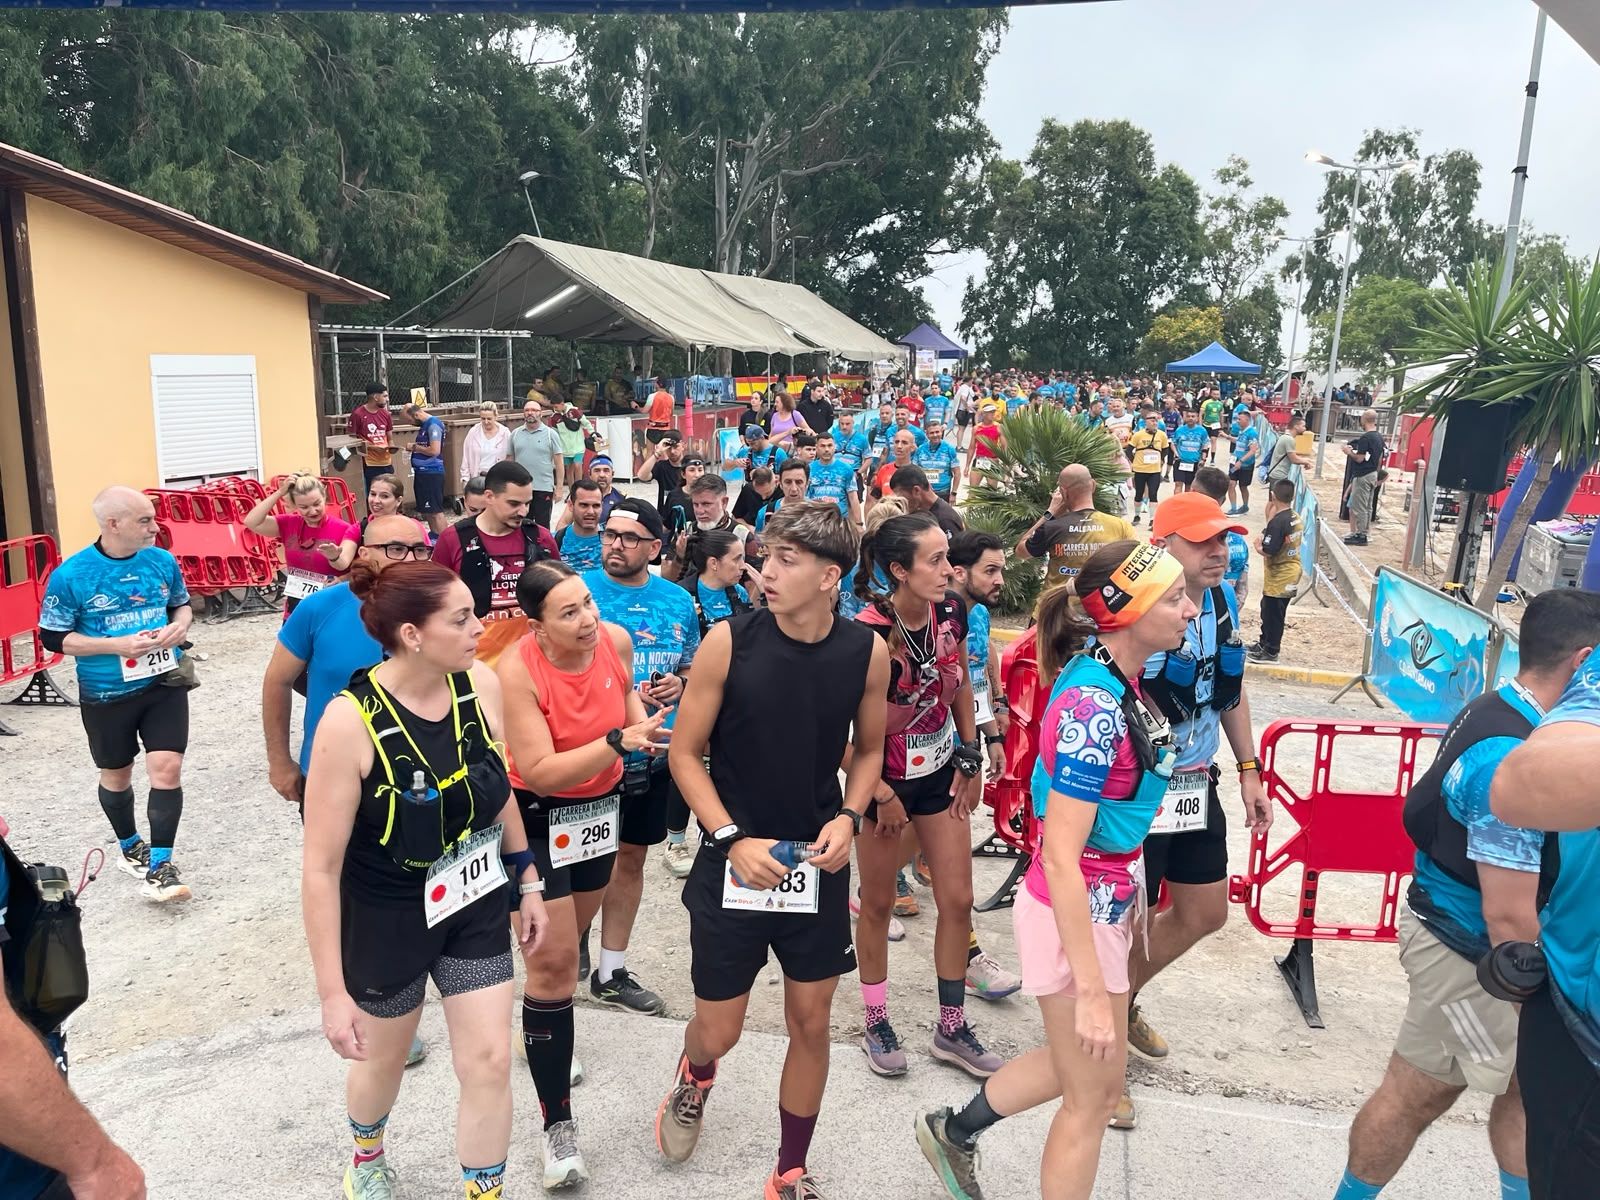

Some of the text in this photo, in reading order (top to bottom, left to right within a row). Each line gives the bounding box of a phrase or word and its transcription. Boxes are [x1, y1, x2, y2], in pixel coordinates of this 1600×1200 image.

[1068, 524, 1105, 533] BALEARIA
[1064, 543, 1089, 552] CARRERA
[500, 573, 521, 581] SIER
[104, 610, 140, 626] CARRERA
[147, 649, 170, 666] 216
[907, 734, 918, 750] IX
[550, 808, 561, 826] IX
[561, 803, 590, 817] CARRERA
[1174, 797, 1200, 817] 408
[581, 821, 610, 846] 296
[459, 851, 489, 887] 101
[771, 871, 806, 894] 83
